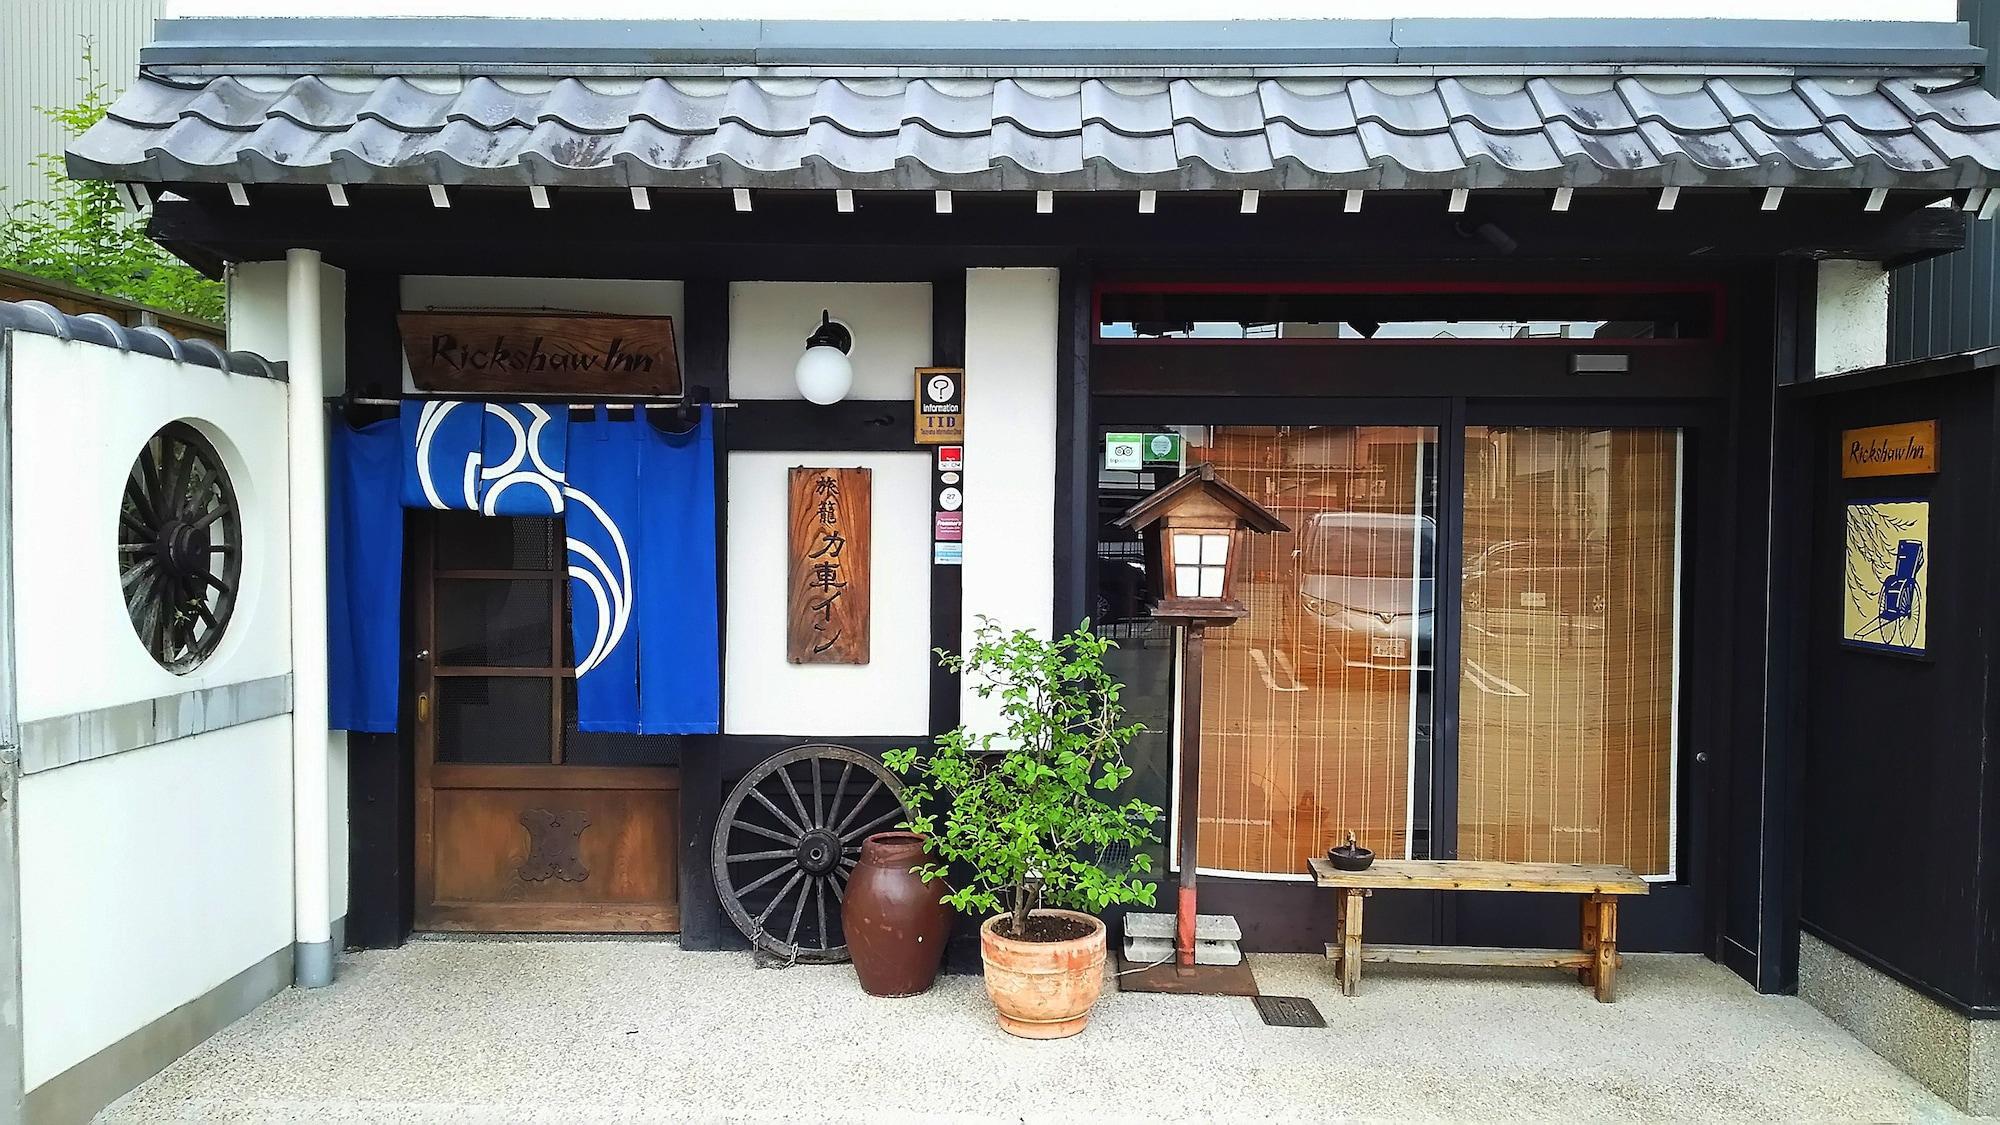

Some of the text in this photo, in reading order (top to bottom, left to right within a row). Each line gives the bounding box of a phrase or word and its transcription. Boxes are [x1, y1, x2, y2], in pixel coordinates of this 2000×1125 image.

[431, 334, 654, 374] Rickshaw Inn
[923, 404, 959, 412] Information
[926, 416, 956, 428] TID
[1849, 435, 1925, 464] Rickshaw Inn
